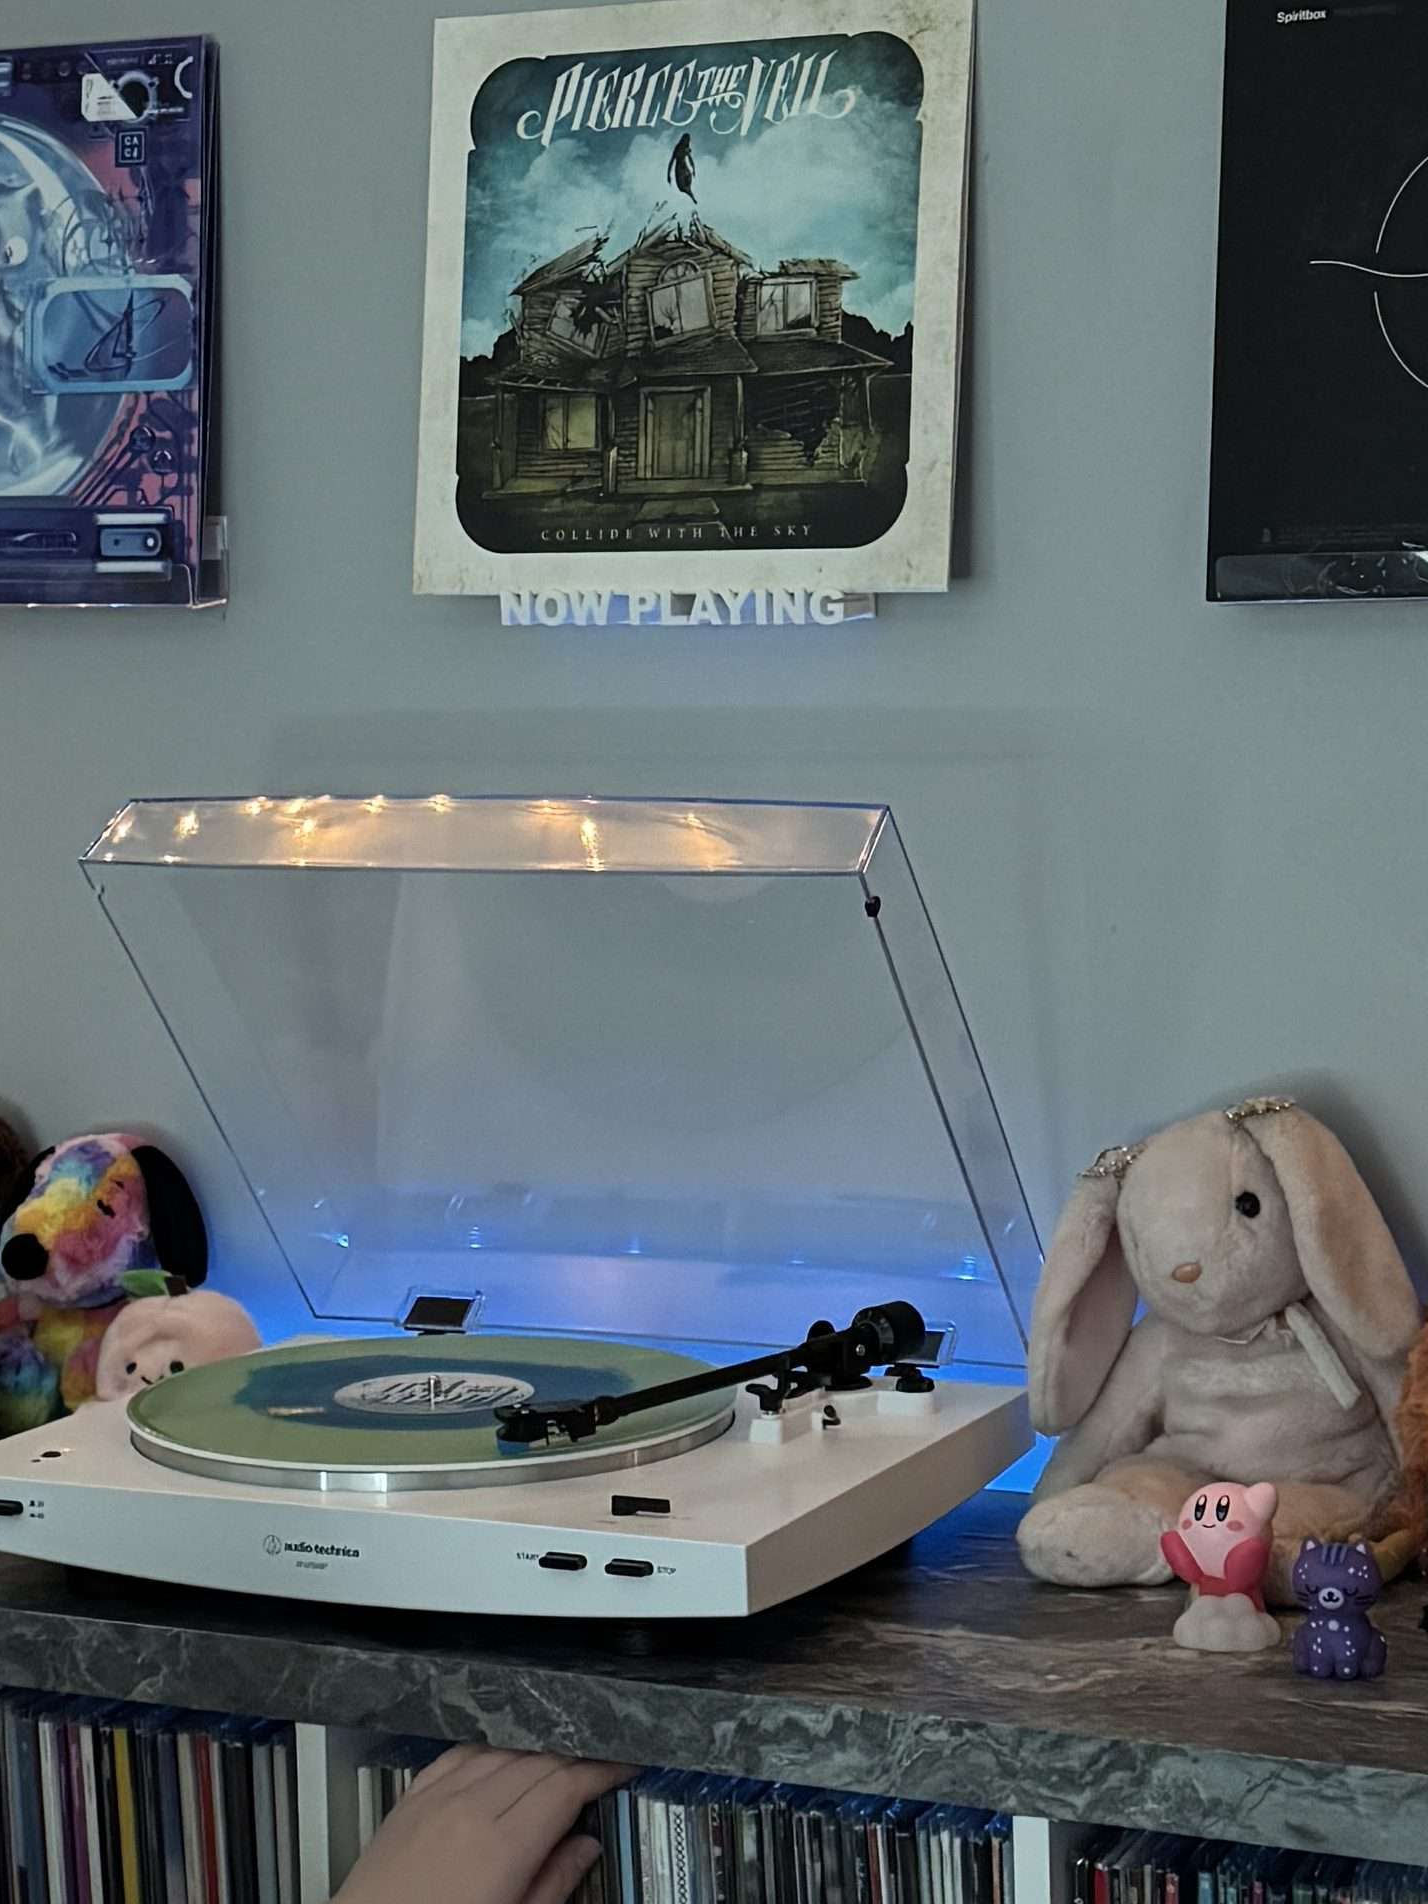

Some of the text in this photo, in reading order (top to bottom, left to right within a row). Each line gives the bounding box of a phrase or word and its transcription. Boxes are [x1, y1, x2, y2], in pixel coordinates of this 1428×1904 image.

[516, 49, 857, 147] PIERCE THE VEIL
[541, 525, 812, 542] COLLIDE WITH THE SKY
[499, 587, 846, 626] NOW PLAYING
